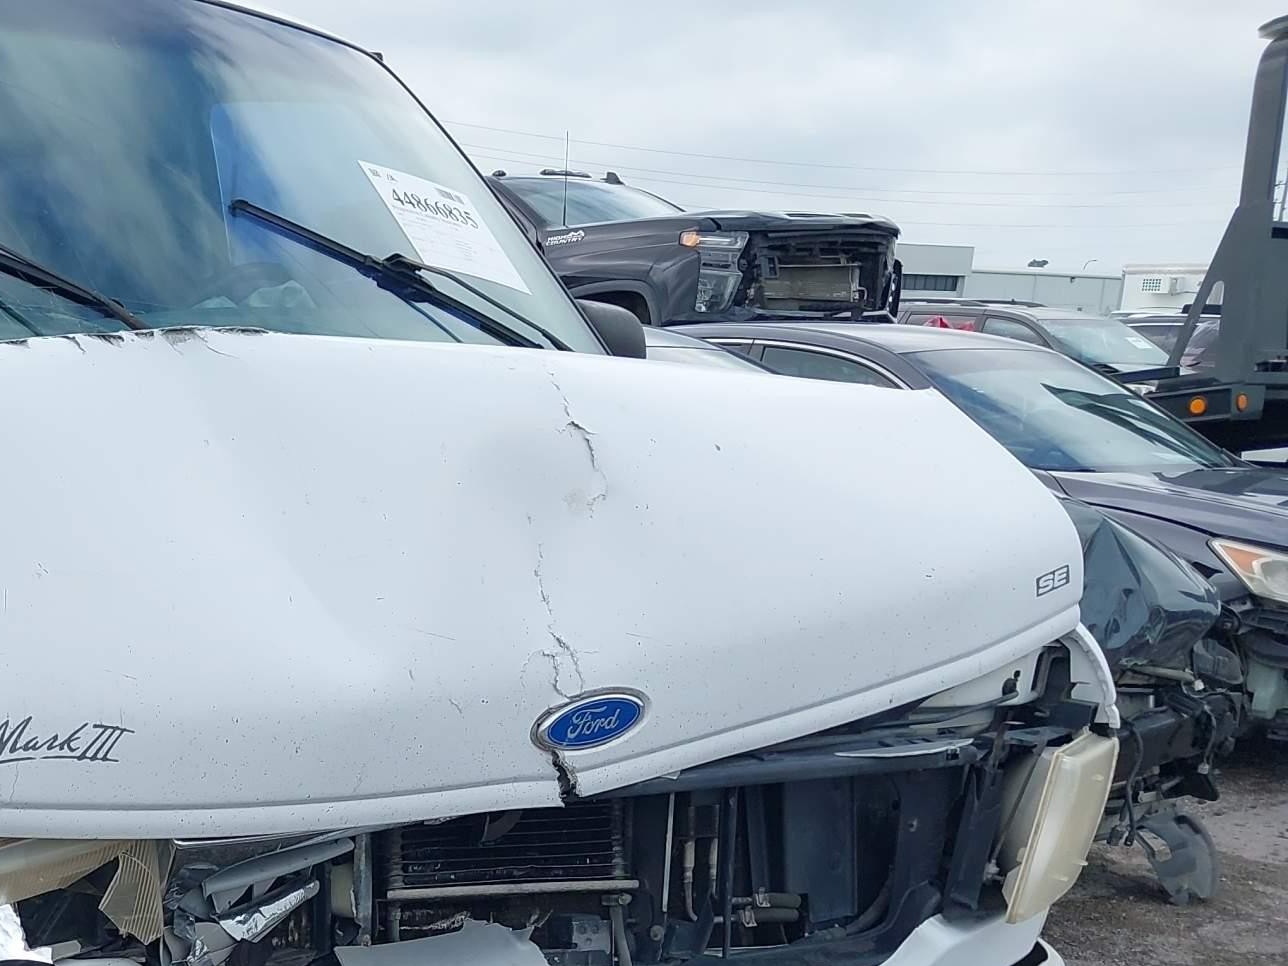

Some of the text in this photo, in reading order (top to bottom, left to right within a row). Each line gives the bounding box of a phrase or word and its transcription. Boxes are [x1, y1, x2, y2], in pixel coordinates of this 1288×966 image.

[392, 188, 479, 229] 44866835
[1035, 564, 1070, 598] SE
[566, 705, 621, 740] Ford
[77, 723, 136, 762] III
